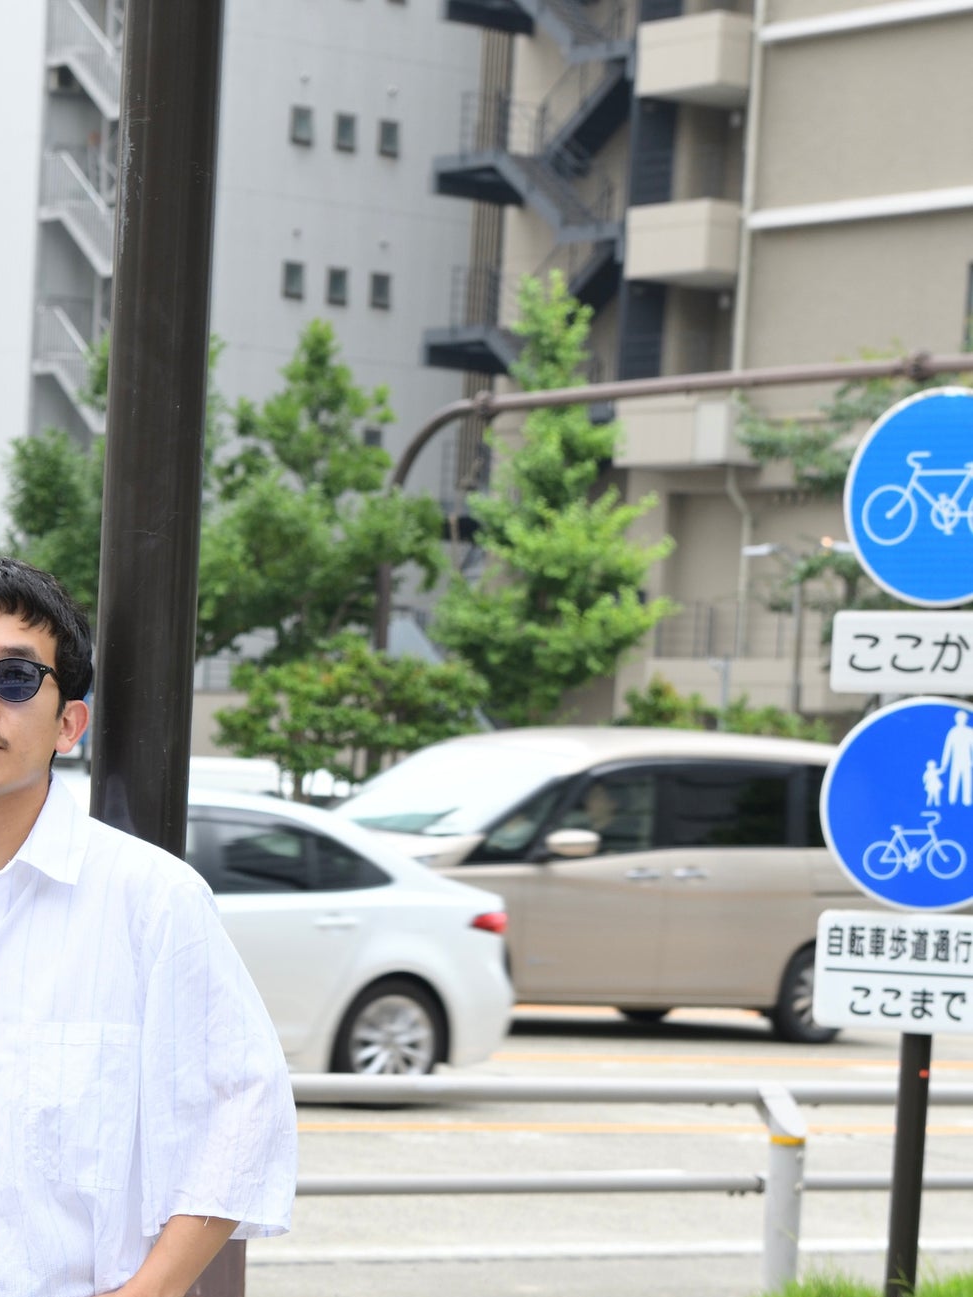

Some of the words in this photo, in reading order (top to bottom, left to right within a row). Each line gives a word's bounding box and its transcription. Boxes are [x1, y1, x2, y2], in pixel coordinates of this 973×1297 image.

[849, 633, 969, 672] ここか
[827, 925, 972, 963] 自転車歩道通行
[849, 987, 966, 1021] ここまで
